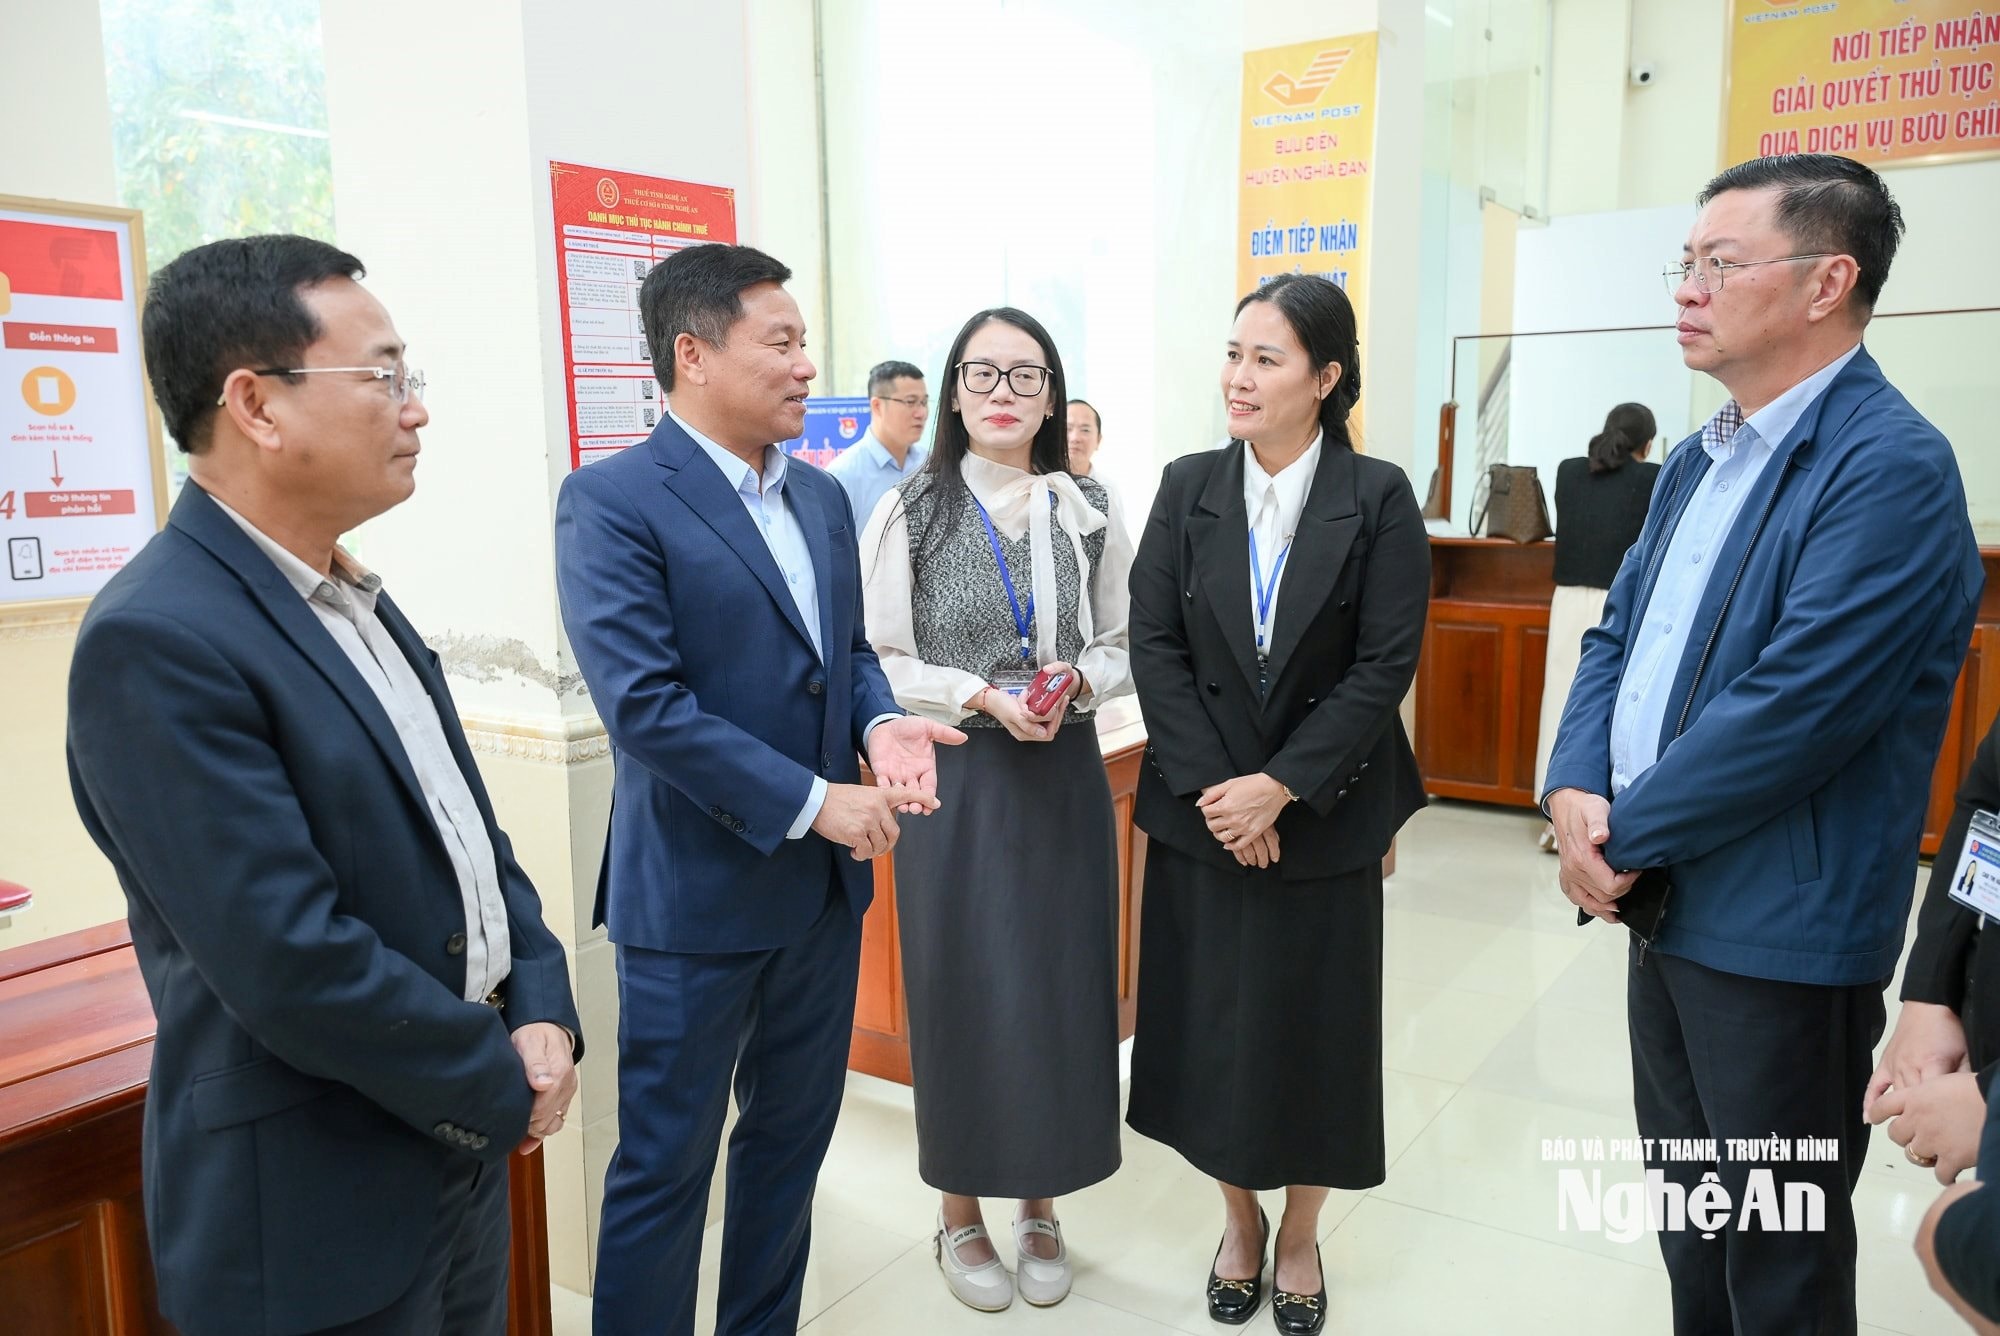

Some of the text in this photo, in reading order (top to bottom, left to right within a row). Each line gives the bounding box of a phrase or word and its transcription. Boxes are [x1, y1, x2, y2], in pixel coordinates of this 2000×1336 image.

[1744, 4, 1837, 22] VIETNAM POST
[1832, 12, 2000, 63] NƠI TIẾP NHẬN
[1773, 60, 1992, 114] GIẢI QUYẾT THỦ TỤC
[1252, 105, 1360, 126] VIETNAM POST
[1867, 120, 1893, 152] VỤ
[1902, 112, 1947, 143] BƯU
[1956, 102, 2000, 138] CHÍ
[588, 211, 708, 235] DANH MỤC THỦ TỤC HÀNH CHÍNH THUẾ
[1288, 219, 1315, 254] TIẾP
[1320, 219, 1357, 256] NHẬN
[53, 333, 81, 346] thông
[82, 335, 95, 344] tin
[0, 490, 16, 519] 4
